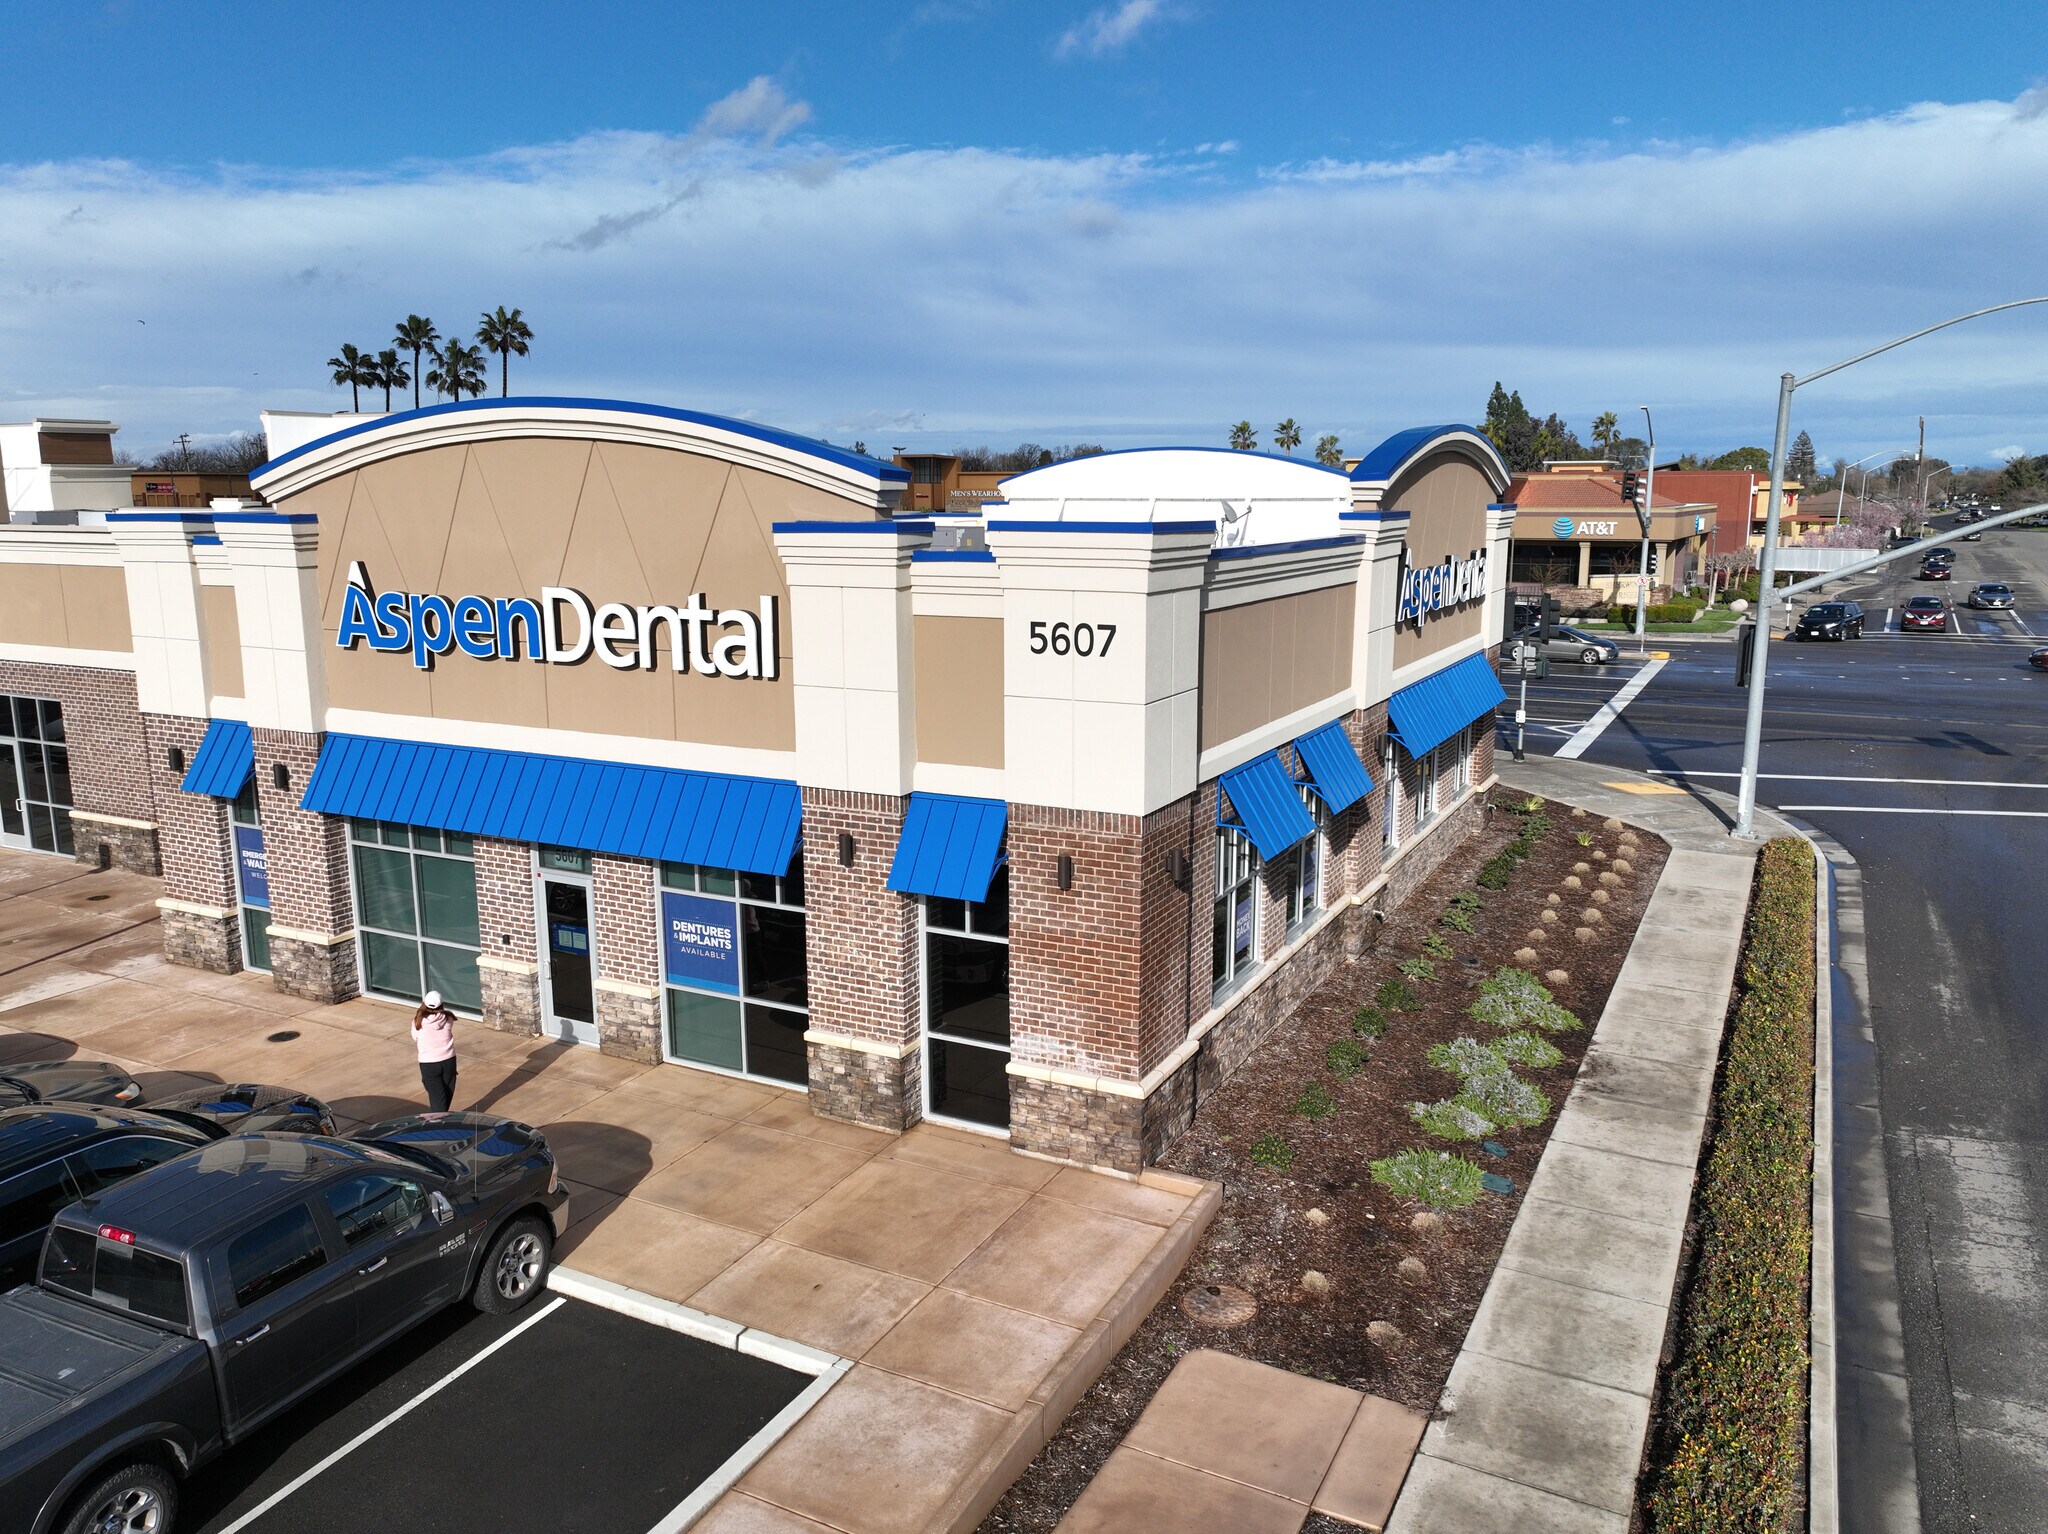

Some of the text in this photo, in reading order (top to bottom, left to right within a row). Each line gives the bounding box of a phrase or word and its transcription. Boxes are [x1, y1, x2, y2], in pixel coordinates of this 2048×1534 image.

[971, 489, 1003, 498] WEARHO
[1576, 521, 1619, 536] AT&T
[1029, 621, 1117, 658] 5607
[251, 871, 268, 880] WELC
[672, 920, 732, 939] DENTURES
[678, 932, 732, 950] IMPLANTS
[680, 946, 727, 961] AVAILABLE
